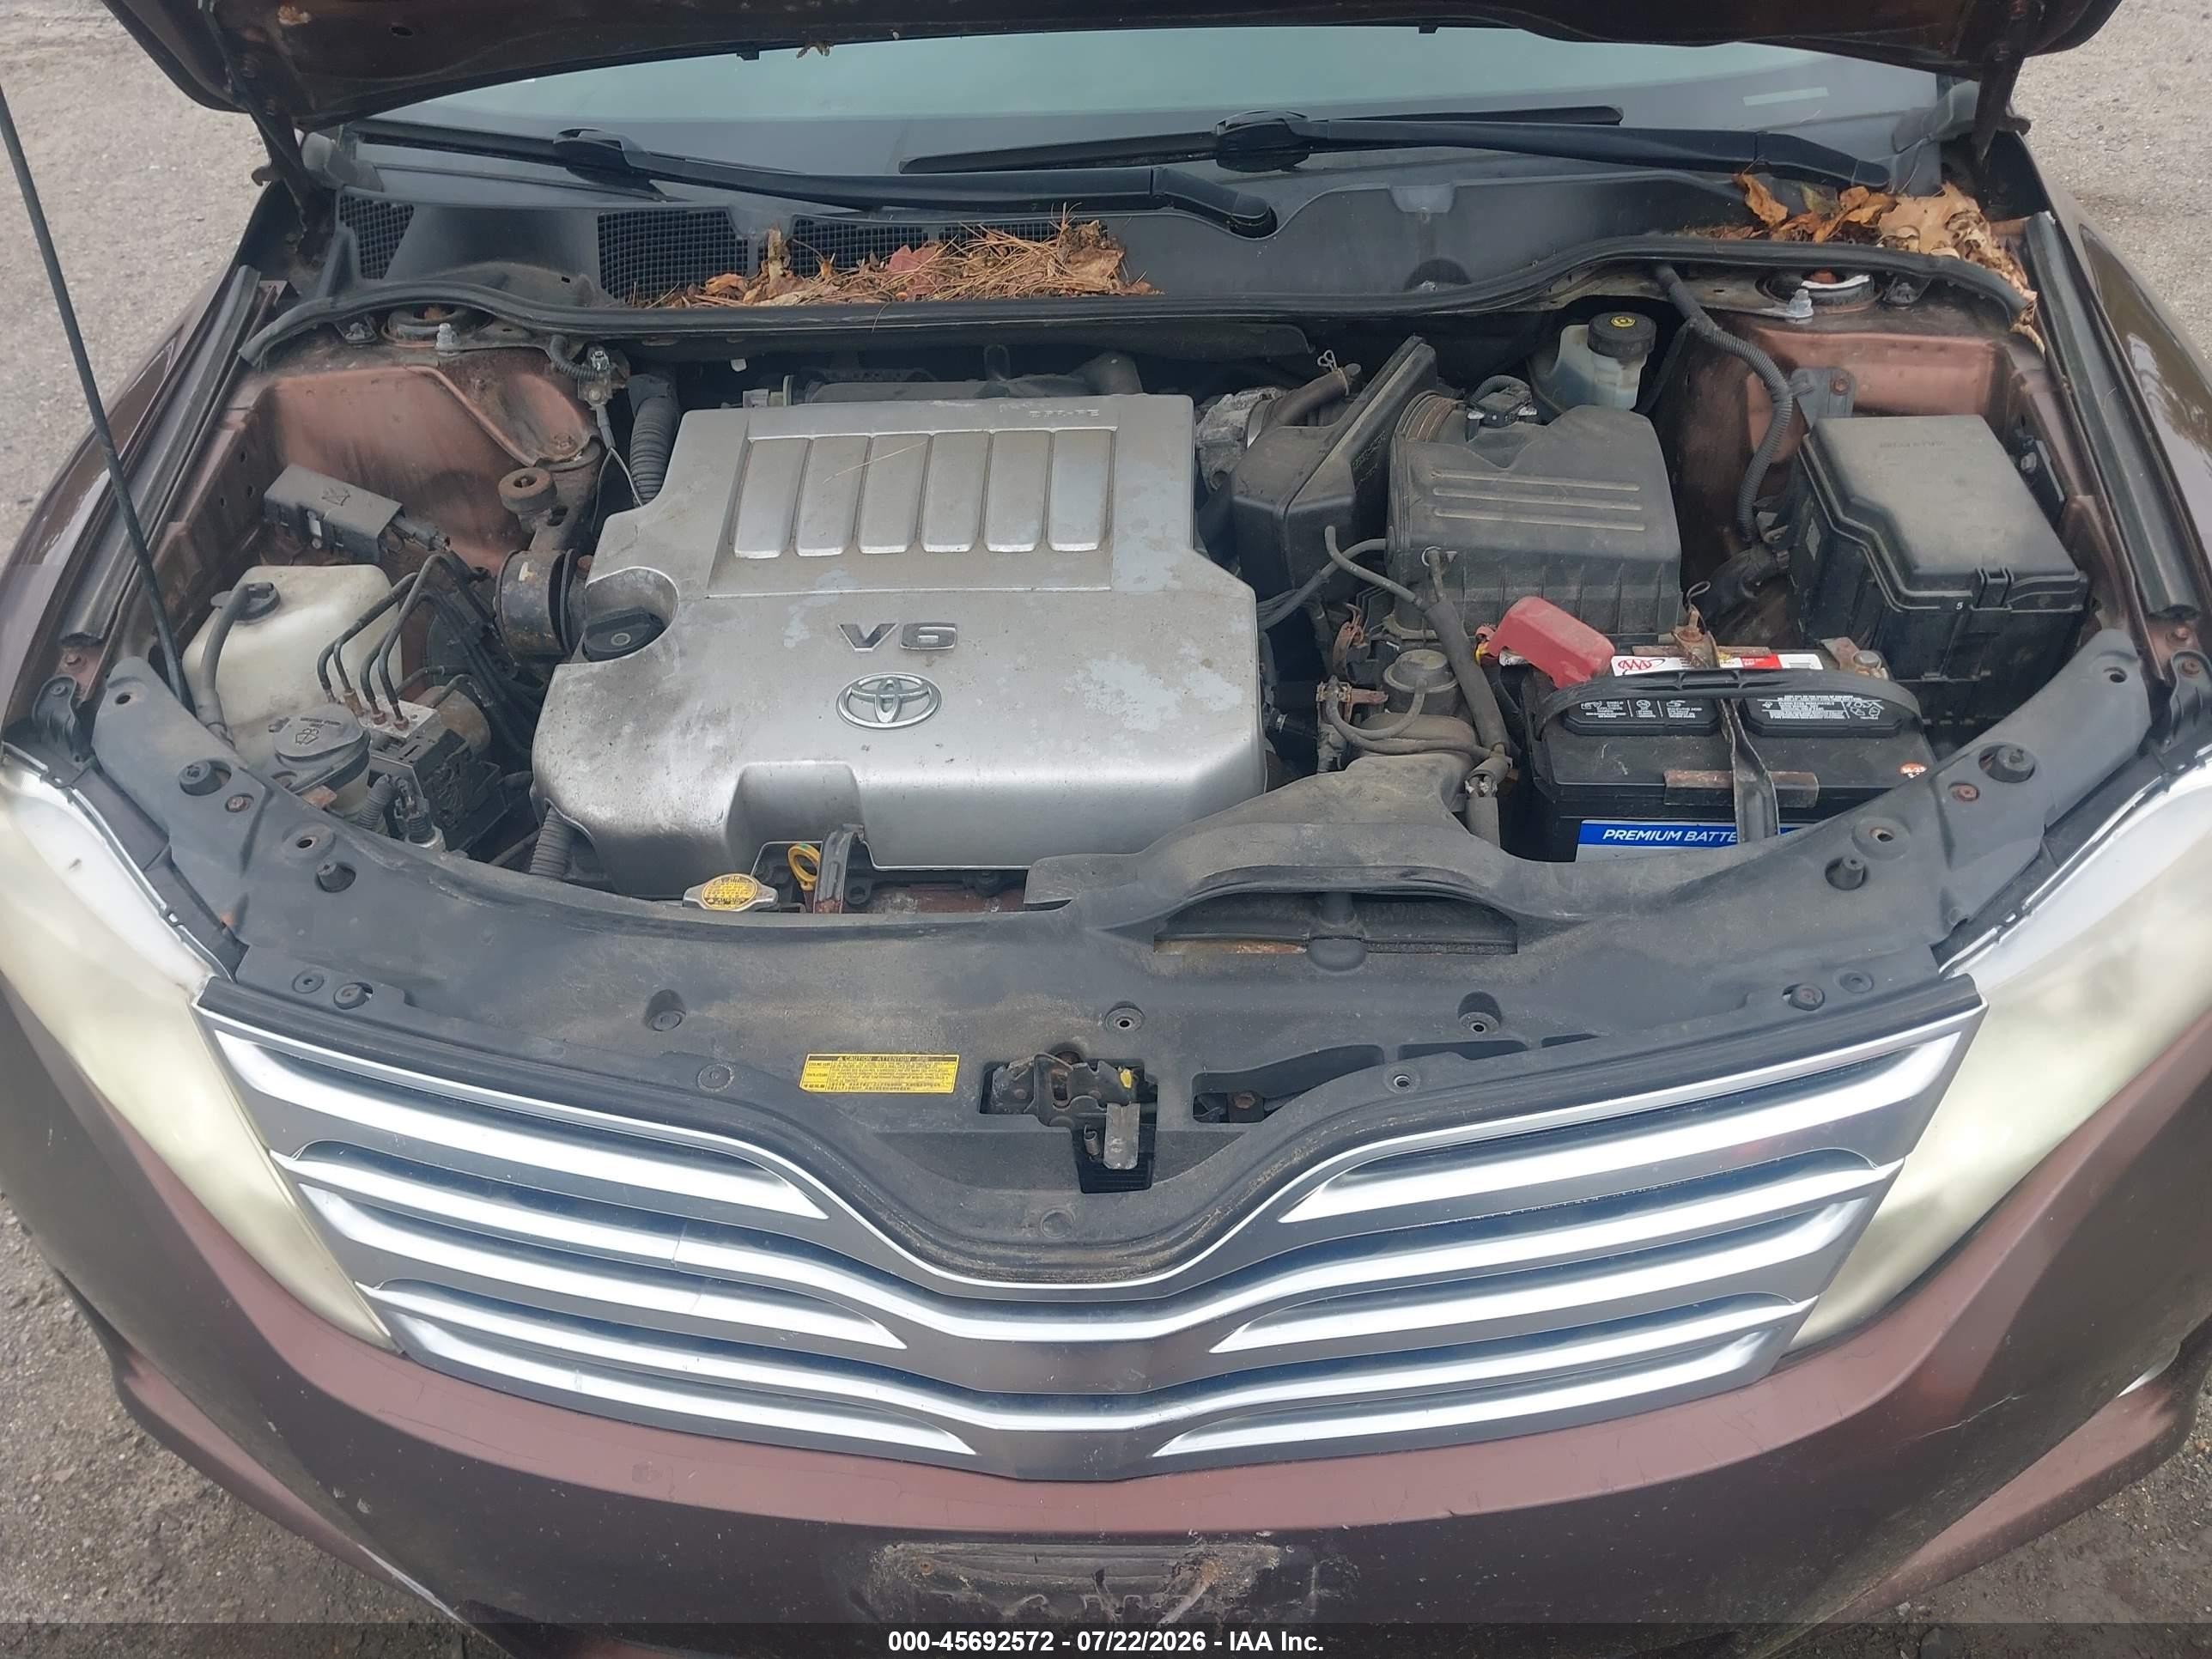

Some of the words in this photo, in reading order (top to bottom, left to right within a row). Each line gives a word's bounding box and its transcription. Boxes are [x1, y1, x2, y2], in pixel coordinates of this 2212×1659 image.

[838, 622, 957, 653] V6
[1620, 659, 1650, 671] AAA
[1602, 829, 1682, 842] PREMIUM
[1684, 830, 1737, 842] BATTE
